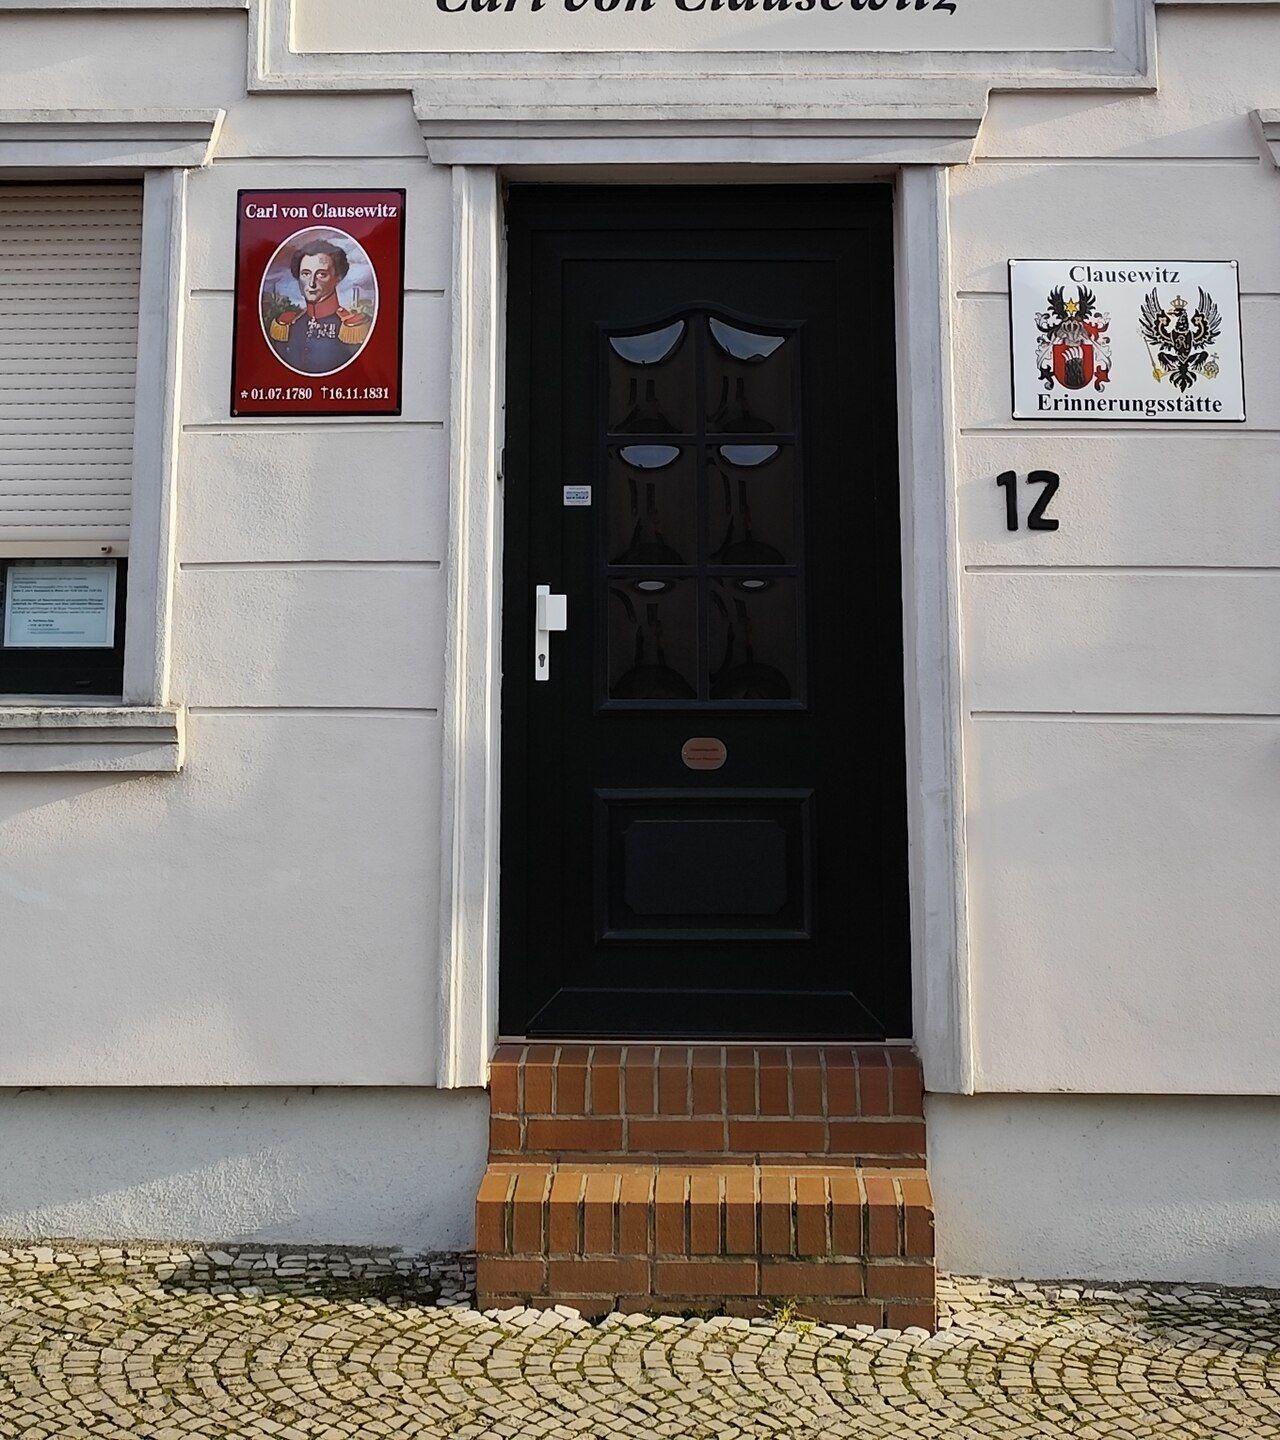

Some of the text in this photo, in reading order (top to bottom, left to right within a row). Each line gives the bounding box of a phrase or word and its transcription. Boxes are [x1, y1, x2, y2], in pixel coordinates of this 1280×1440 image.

[245, 203, 397, 219] Carl von Clausewitz
[1069, 265, 1180, 283] Clausewitz
[251, 387, 313, 400] 01.07.1780
[1037, 393, 1223, 416] Erinnerungsstätte
[996, 469, 1060, 532] 12
